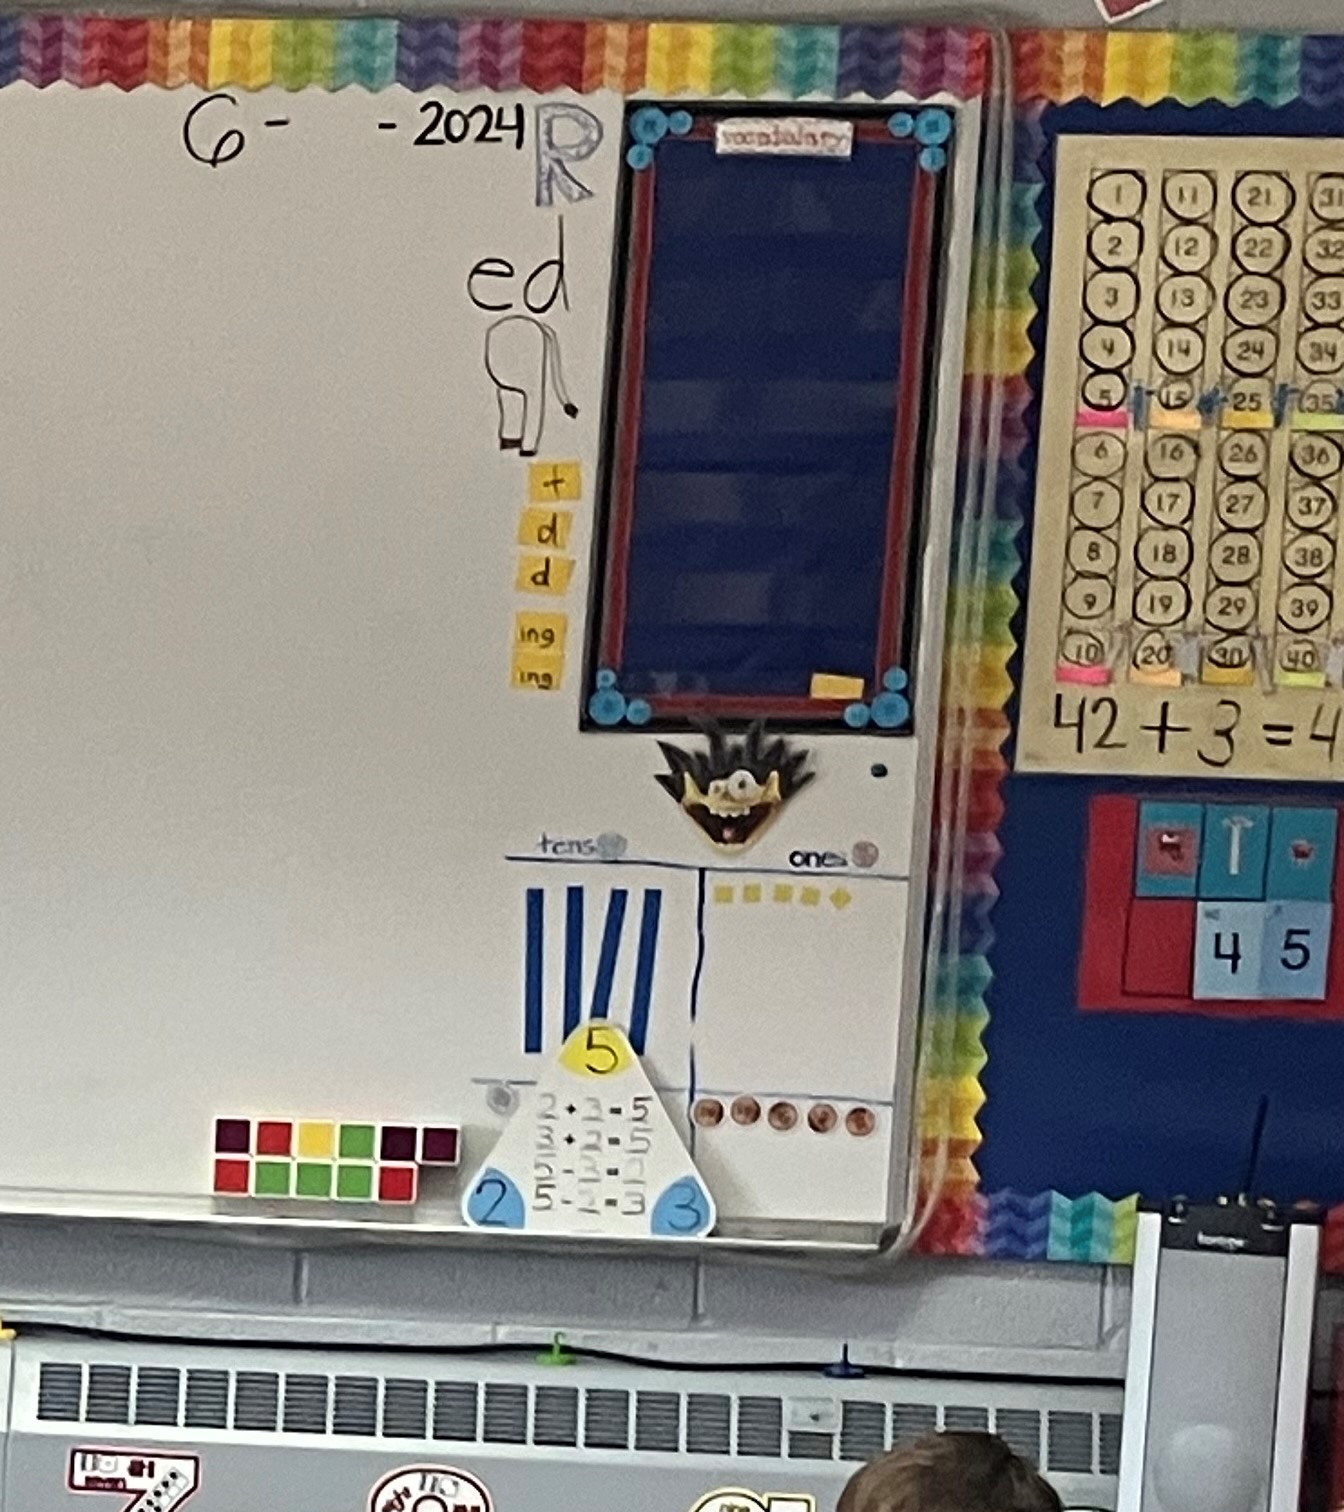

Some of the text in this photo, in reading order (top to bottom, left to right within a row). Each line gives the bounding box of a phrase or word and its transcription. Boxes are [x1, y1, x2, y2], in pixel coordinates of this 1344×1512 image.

[535, 103, 604, 206] R
[1114, 184, 1343, 206] 1 11 21 31
[1108, 236, 1122, 256] 2
[1175, 237, 1199, 257] 12
[1243, 238, 1272, 258] 22
[467, 214, 569, 313] ed
[1106, 287, 1341, 310] 3 13 23 33
[1101, 338, 1337, 363] 4 14 24 34
[1099, 389, 1112, 407] 5
[1233, 392, 1262, 412] 25
[1305, 393, 1334, 412] 35
[1094, 441, 1330, 464] 6 16 26 36
[1092, 491, 1327, 516] 7 17 27 37
[538, 512, 557, 546] d
[1087, 542, 1324, 568] 8 18 28 38
[530, 556, 550, 587] d
[1084, 592, 1319, 618] 9 19 29 39
[519, 622, 556, 648] ing
[1076, 643, 1315, 669] 10 20 30 40
[519, 666, 553, 689] ing
[1054, 694, 1127, 753] 42
[1139, 701, 1191, 754] +
[1197, 699, 1242, 768] 3
[539, 832, 597, 855] tens
[789, 850, 848, 868] ones
[1214, 932, 1241, 974] 4
[1280, 928, 1310, 970] 5
[585, 1026, 618, 1074] 5
[629, 1096, 653, 1122] 5
[476, 1179, 506, 1227] 2
[532, 1184, 556, 1211] 5
[668, 1183, 701, 1231] 3
